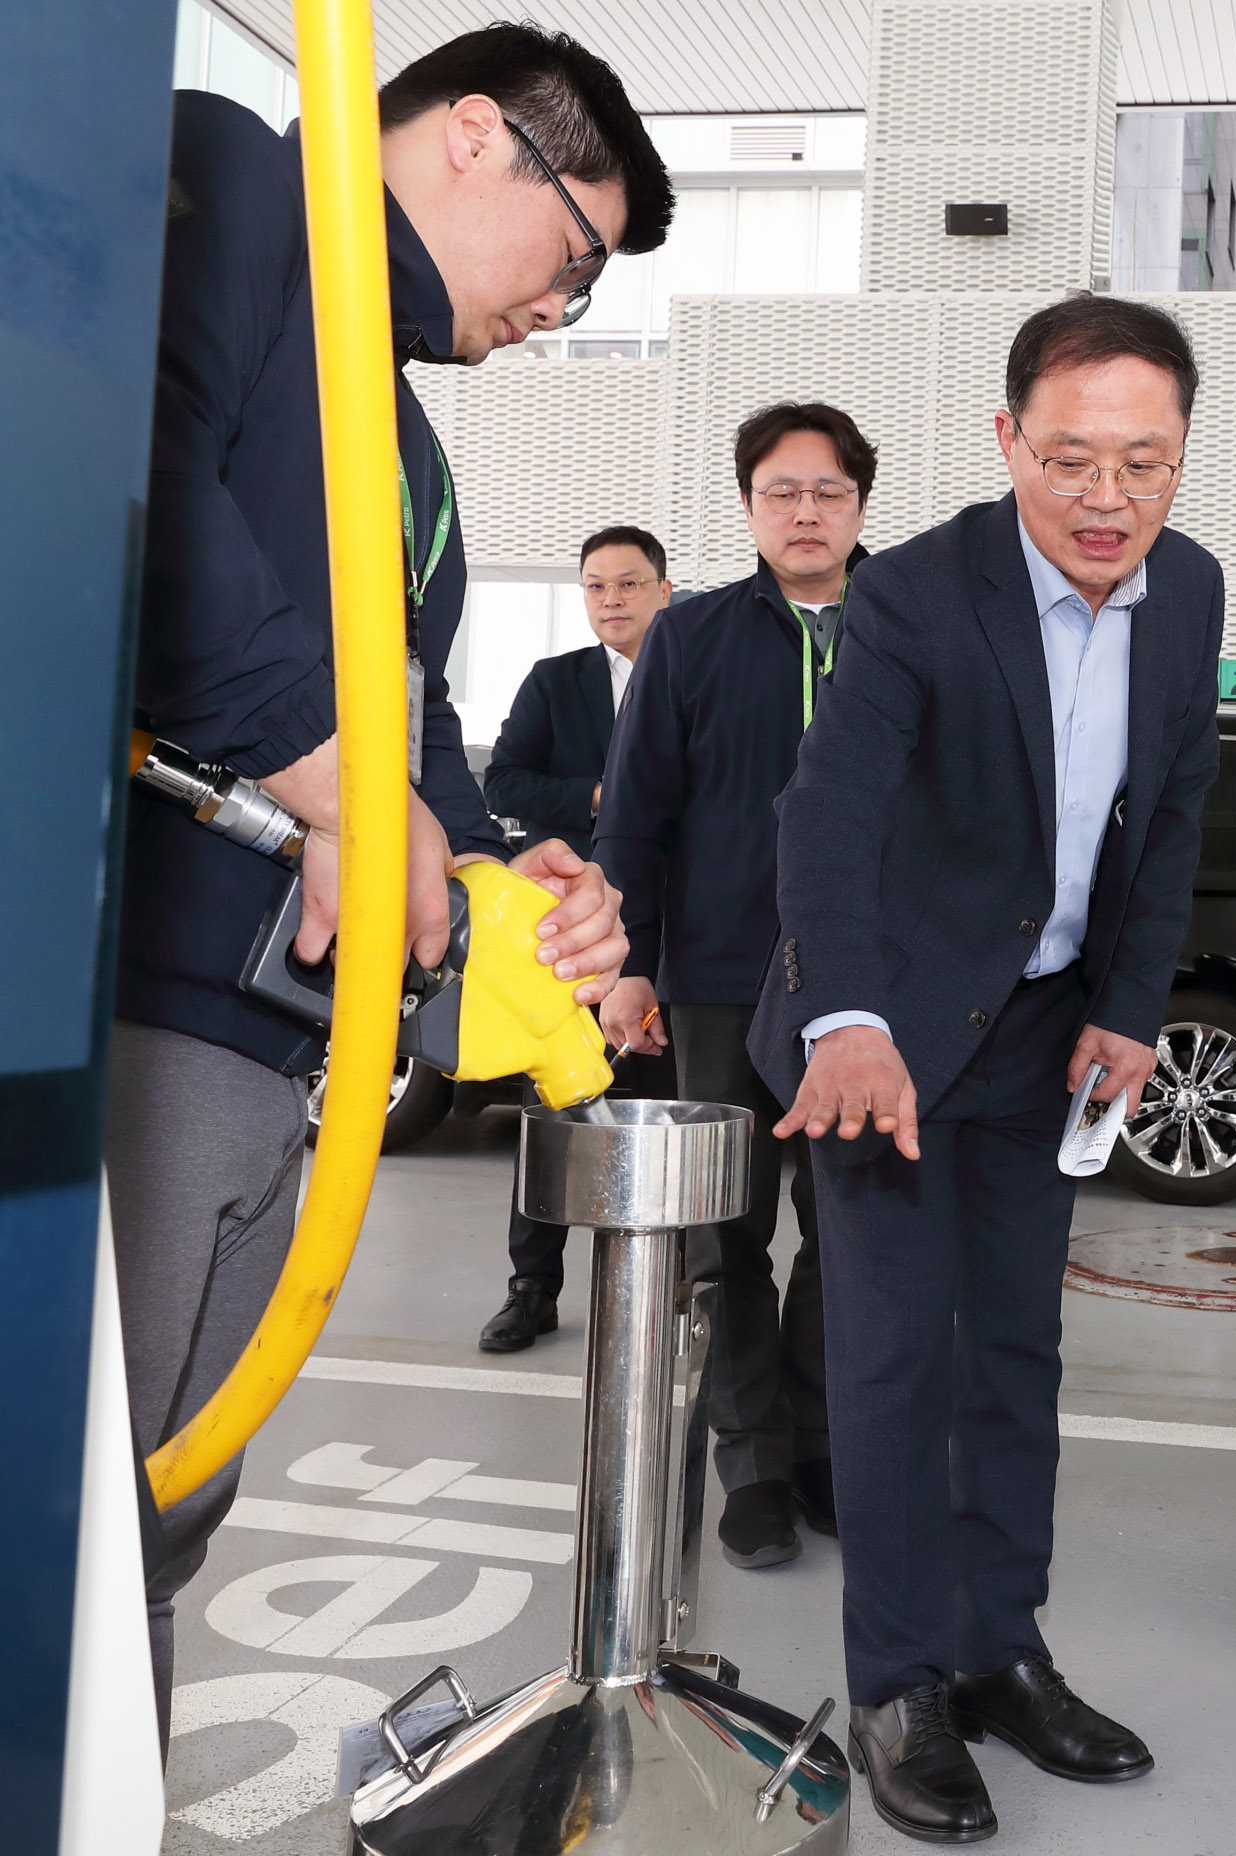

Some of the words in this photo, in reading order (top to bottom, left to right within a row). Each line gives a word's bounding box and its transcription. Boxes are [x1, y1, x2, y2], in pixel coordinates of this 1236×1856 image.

[441, 509, 450, 524] Petro
[439, 522, 447, 532] K
[404, 528, 411, 537] K
[427, 566, 434, 577] K
